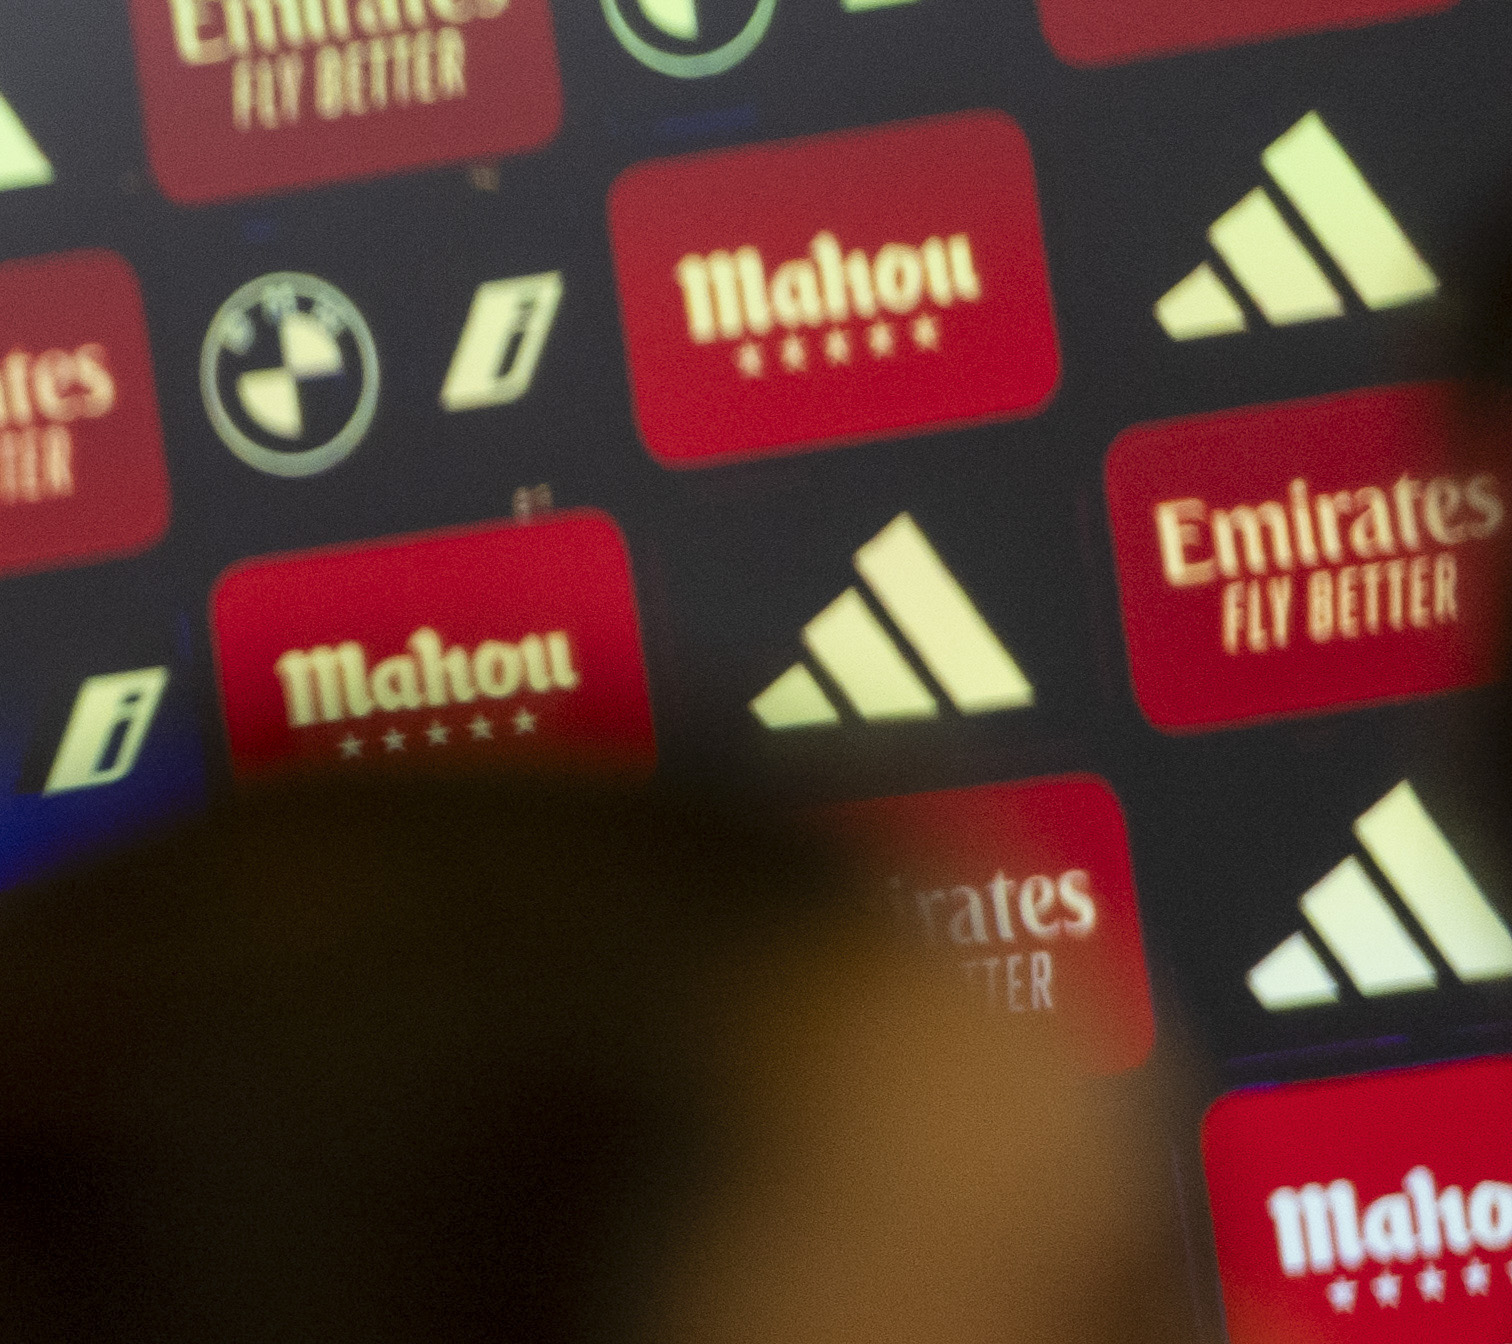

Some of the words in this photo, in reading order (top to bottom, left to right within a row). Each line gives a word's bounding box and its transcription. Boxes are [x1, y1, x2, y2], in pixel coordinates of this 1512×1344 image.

[677, 229, 980, 344] Mahou
[1153, 469, 1506, 586] Emirates
[1221, 569, 1297, 656] FLY
[1308, 552, 1460, 642] BETTER
[277, 627, 579, 727] Mahou
[1268, 1165, 1512, 1278] Maho
